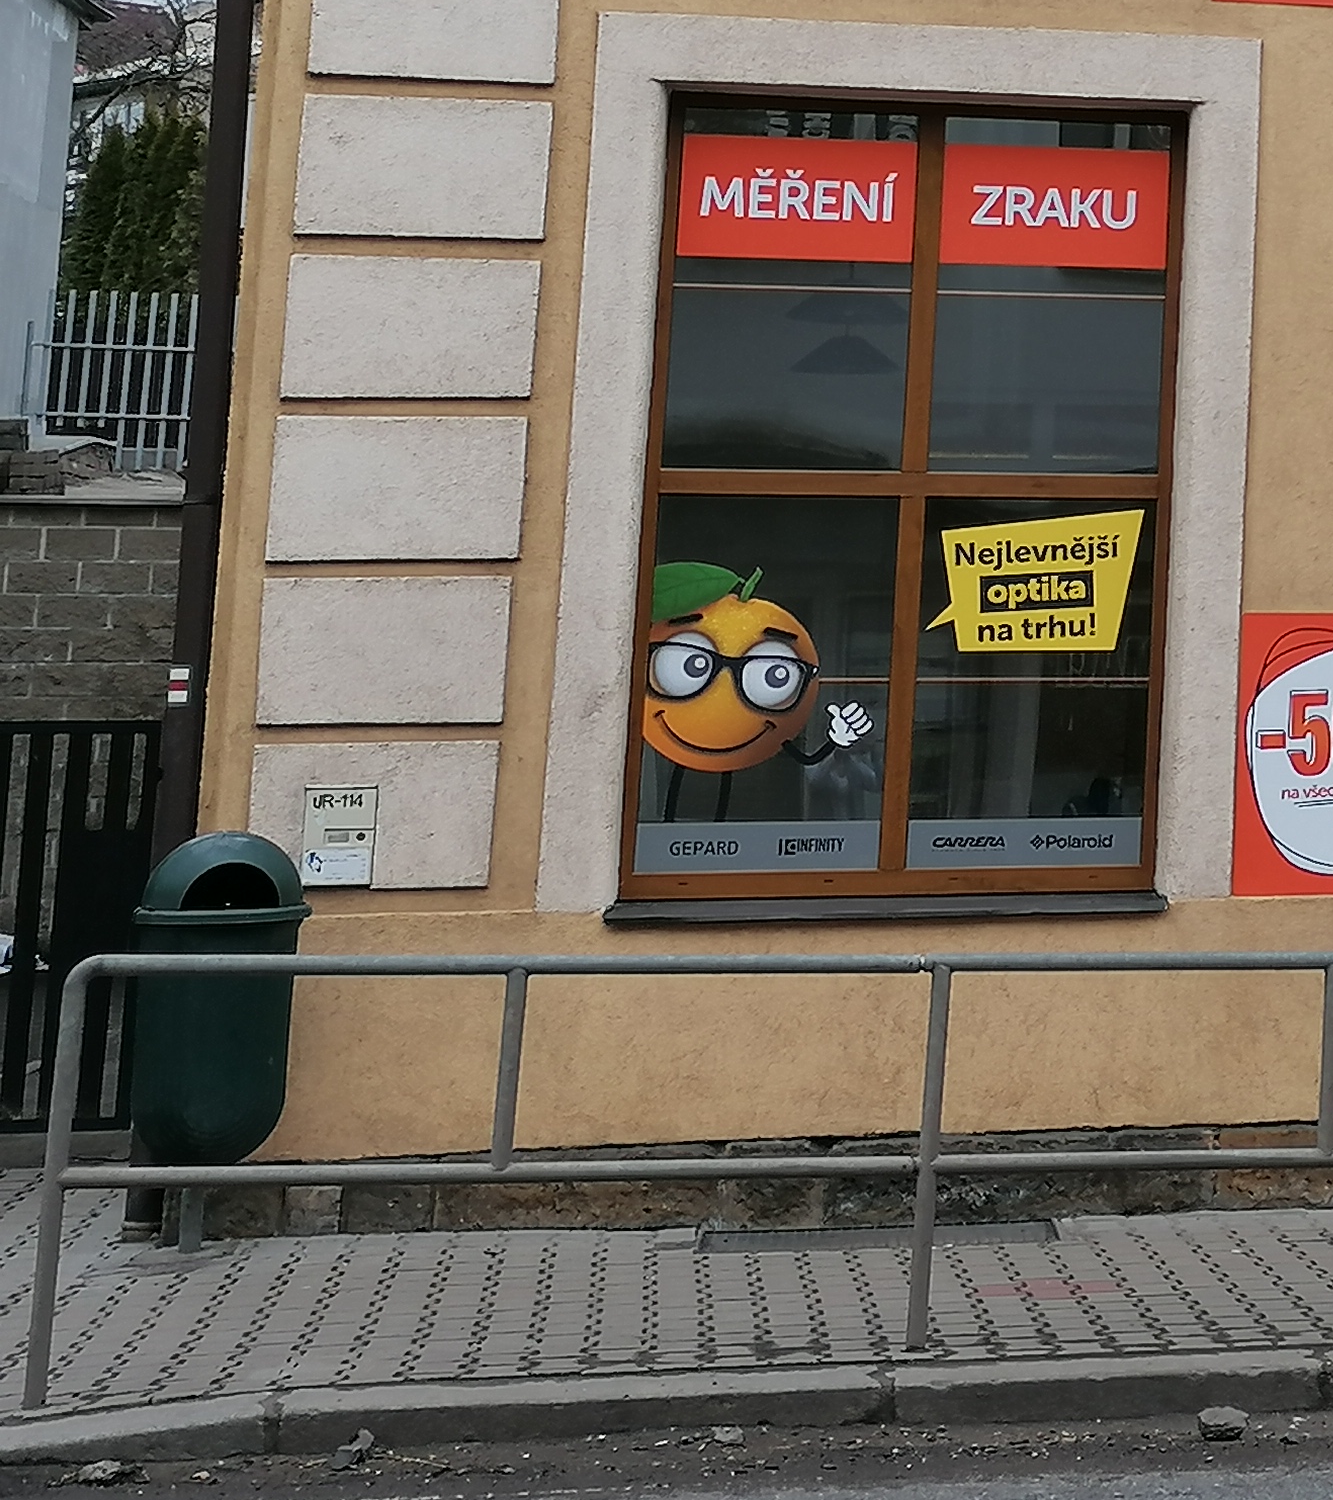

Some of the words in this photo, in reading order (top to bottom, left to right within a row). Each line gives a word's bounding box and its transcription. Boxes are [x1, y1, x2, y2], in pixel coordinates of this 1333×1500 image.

[700, 168, 900, 223] MĚŘENÍ
[971, 185, 1139, 231] ZRAKU
[954, 534, 1120, 570] Nejlevnější
[986, 575, 1088, 610] optika
[977, 622, 1013, 642] na
[1021, 613, 1096, 640] trhu!
[1281, 785, 1300, 799] na
[313, 793, 363, 810] UR-114
[669, 841, 739, 857] GEPARD
[931, 836, 1006, 848] CARRERA
[1045, 833, 1115, 849] Polaroid
